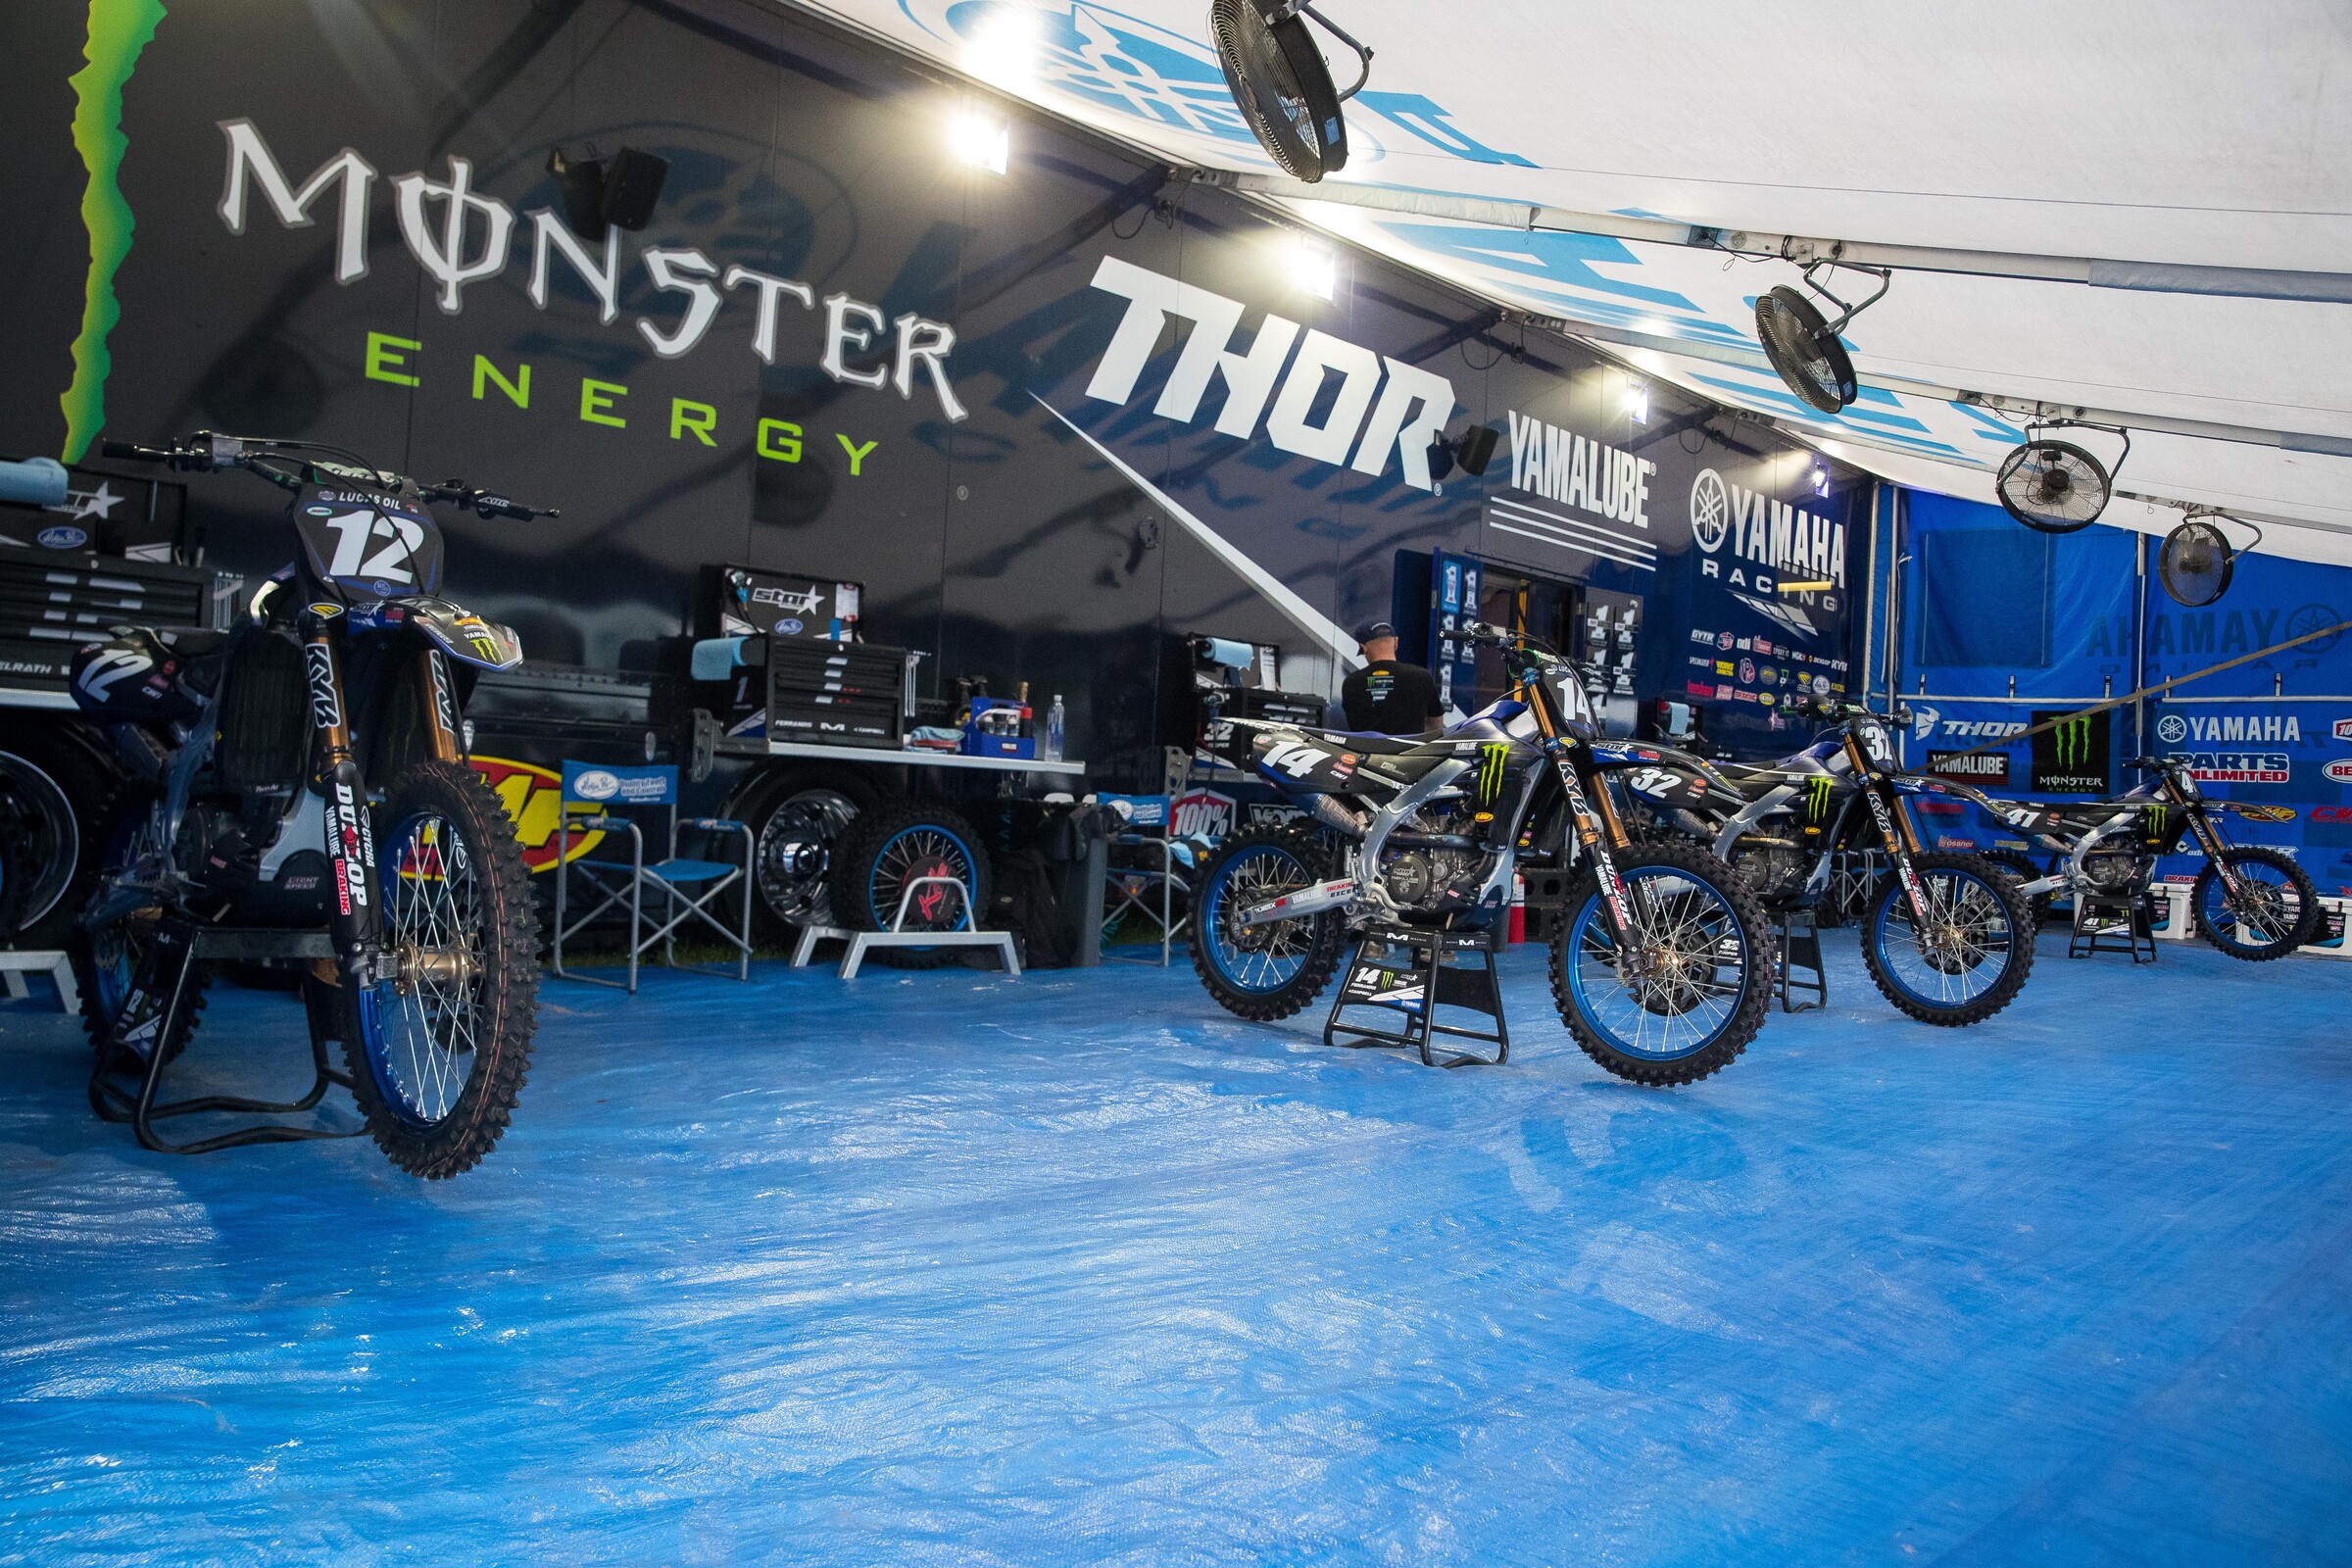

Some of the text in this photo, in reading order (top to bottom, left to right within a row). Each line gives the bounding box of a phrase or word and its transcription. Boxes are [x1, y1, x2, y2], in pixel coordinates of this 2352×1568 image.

[218, 119, 968, 422] MONSTER
[1085, 255, 1456, 492] THOR
[366, 331, 879, 475] ENERGY
[1509, 410, 1650, 529] YAMALUBE
[338, 491, 401, 510] LUCAS OIL
[326, 509, 425, 585] 12
[1732, 484, 1845, 589] YAMAHA
[1702, 558, 1838, 612] RACING
[1690, 628, 1715, 643] GYTR
[78, 648, 154, 703] 12
[1831, 660, 1847, 671] KYB
[306, 643, 340, 728] KYB
[1942, 720, 2029, 737] THOR
[2189, 716, 2301, 741] YAMAHA
[1261, 741, 1332, 778] 14
[1932, 754, 2004, 775] YAMALUBE
[2188, 769, 2288, 783] NLIMITED
[1558, 761, 1590, 816] KYB
[1630, 768, 1683, 799] 32
[2039, 775, 2104, 787] MONSTER
[324, 806, 341, 858] YAMALUBE
[1173, 802, 1229, 837] 100%
[1866, 792, 1892, 833] KYB
[2005, 808, 2040, 828] 41
[335, 859, 351, 915] BRAKING
[1354, 966, 1382, 985] 14
